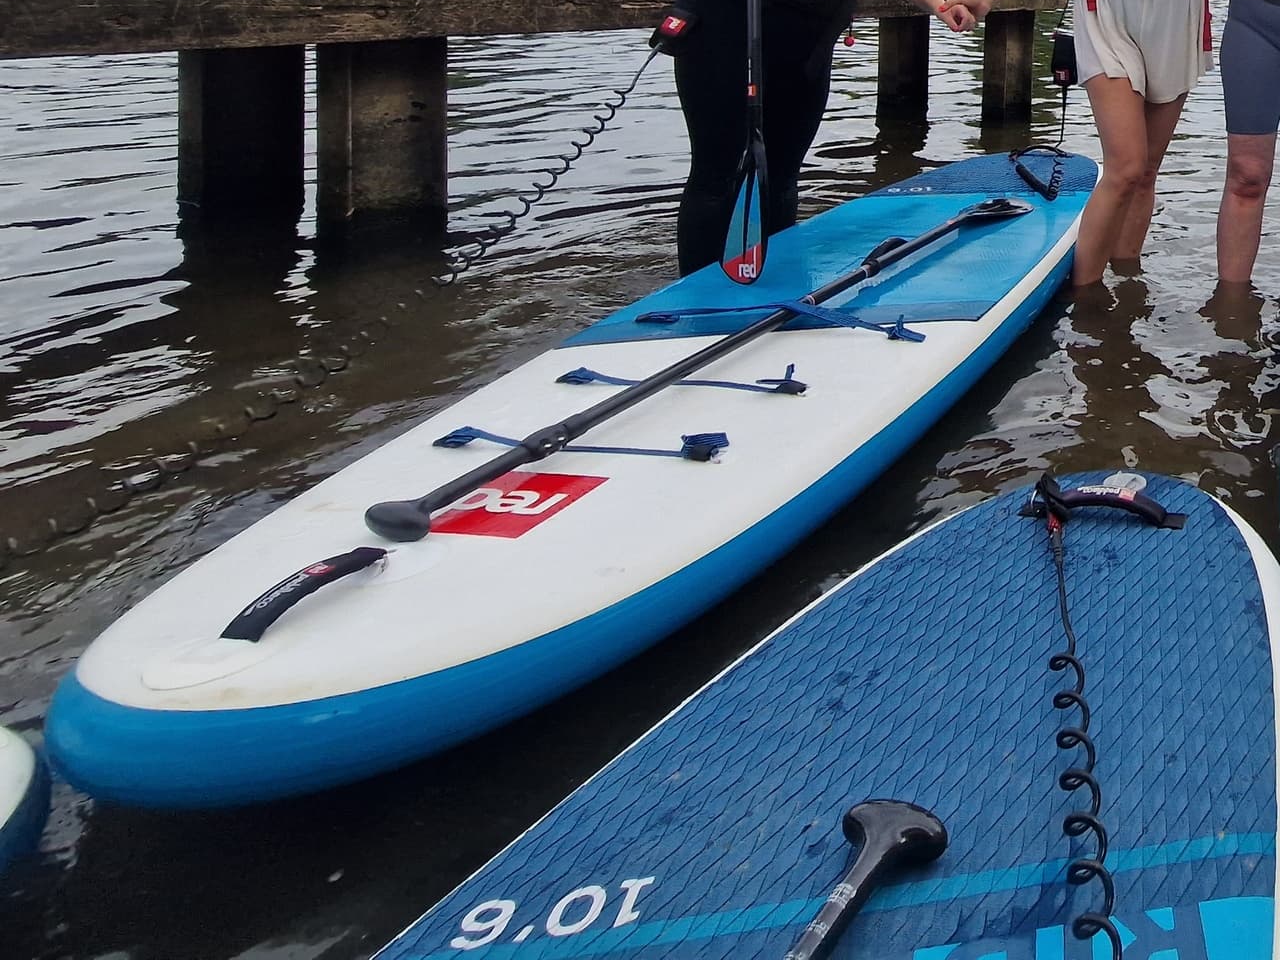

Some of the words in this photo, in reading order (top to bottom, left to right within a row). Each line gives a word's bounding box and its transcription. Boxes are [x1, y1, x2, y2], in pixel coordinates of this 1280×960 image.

[738, 246, 757, 278] red
[434, 488, 570, 515] red
[450, 876, 656, 951] 10'6
